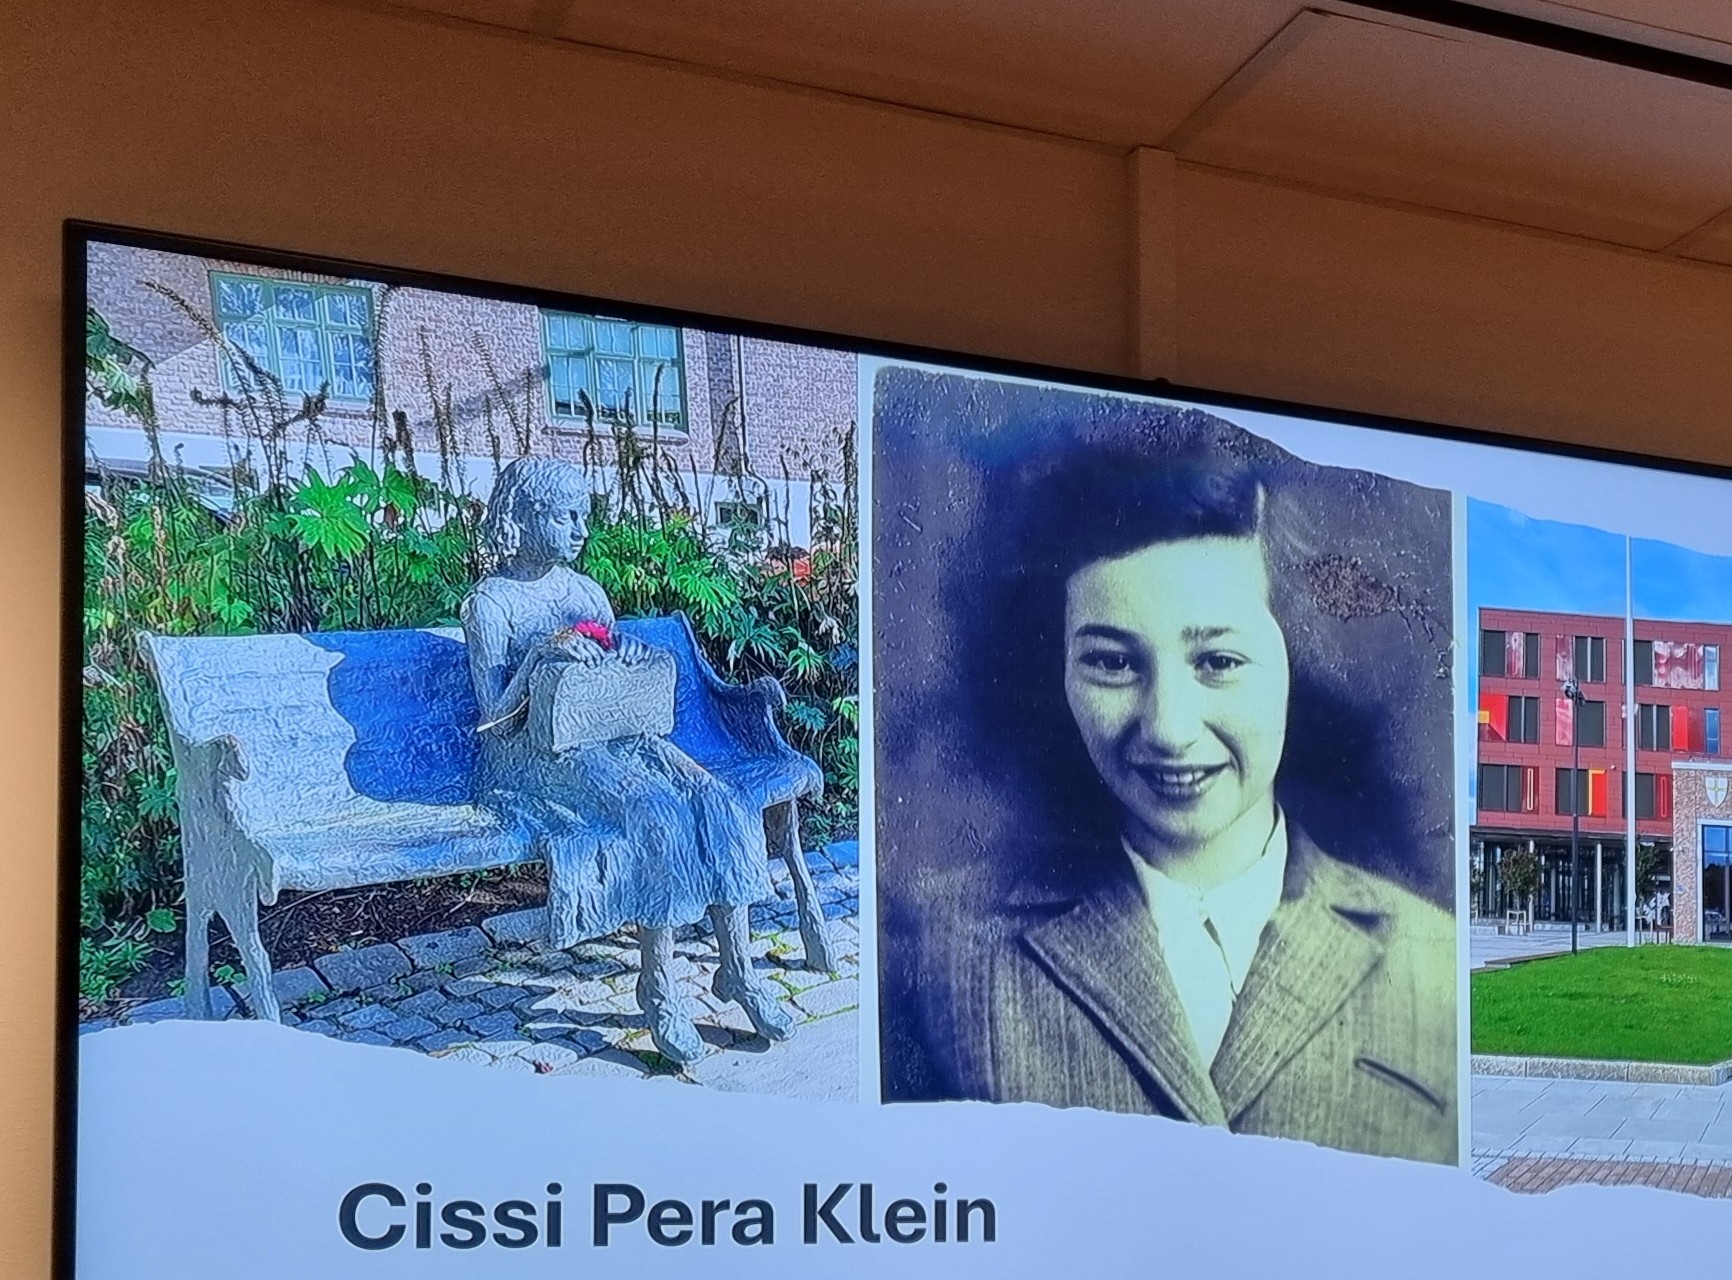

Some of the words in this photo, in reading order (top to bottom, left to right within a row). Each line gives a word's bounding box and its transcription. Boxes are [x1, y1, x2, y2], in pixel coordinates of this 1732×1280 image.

[338, 1182, 563, 1251] Cissi
[592, 1183, 775, 1247] Pera
[803, 1181, 996, 1245] Klein
